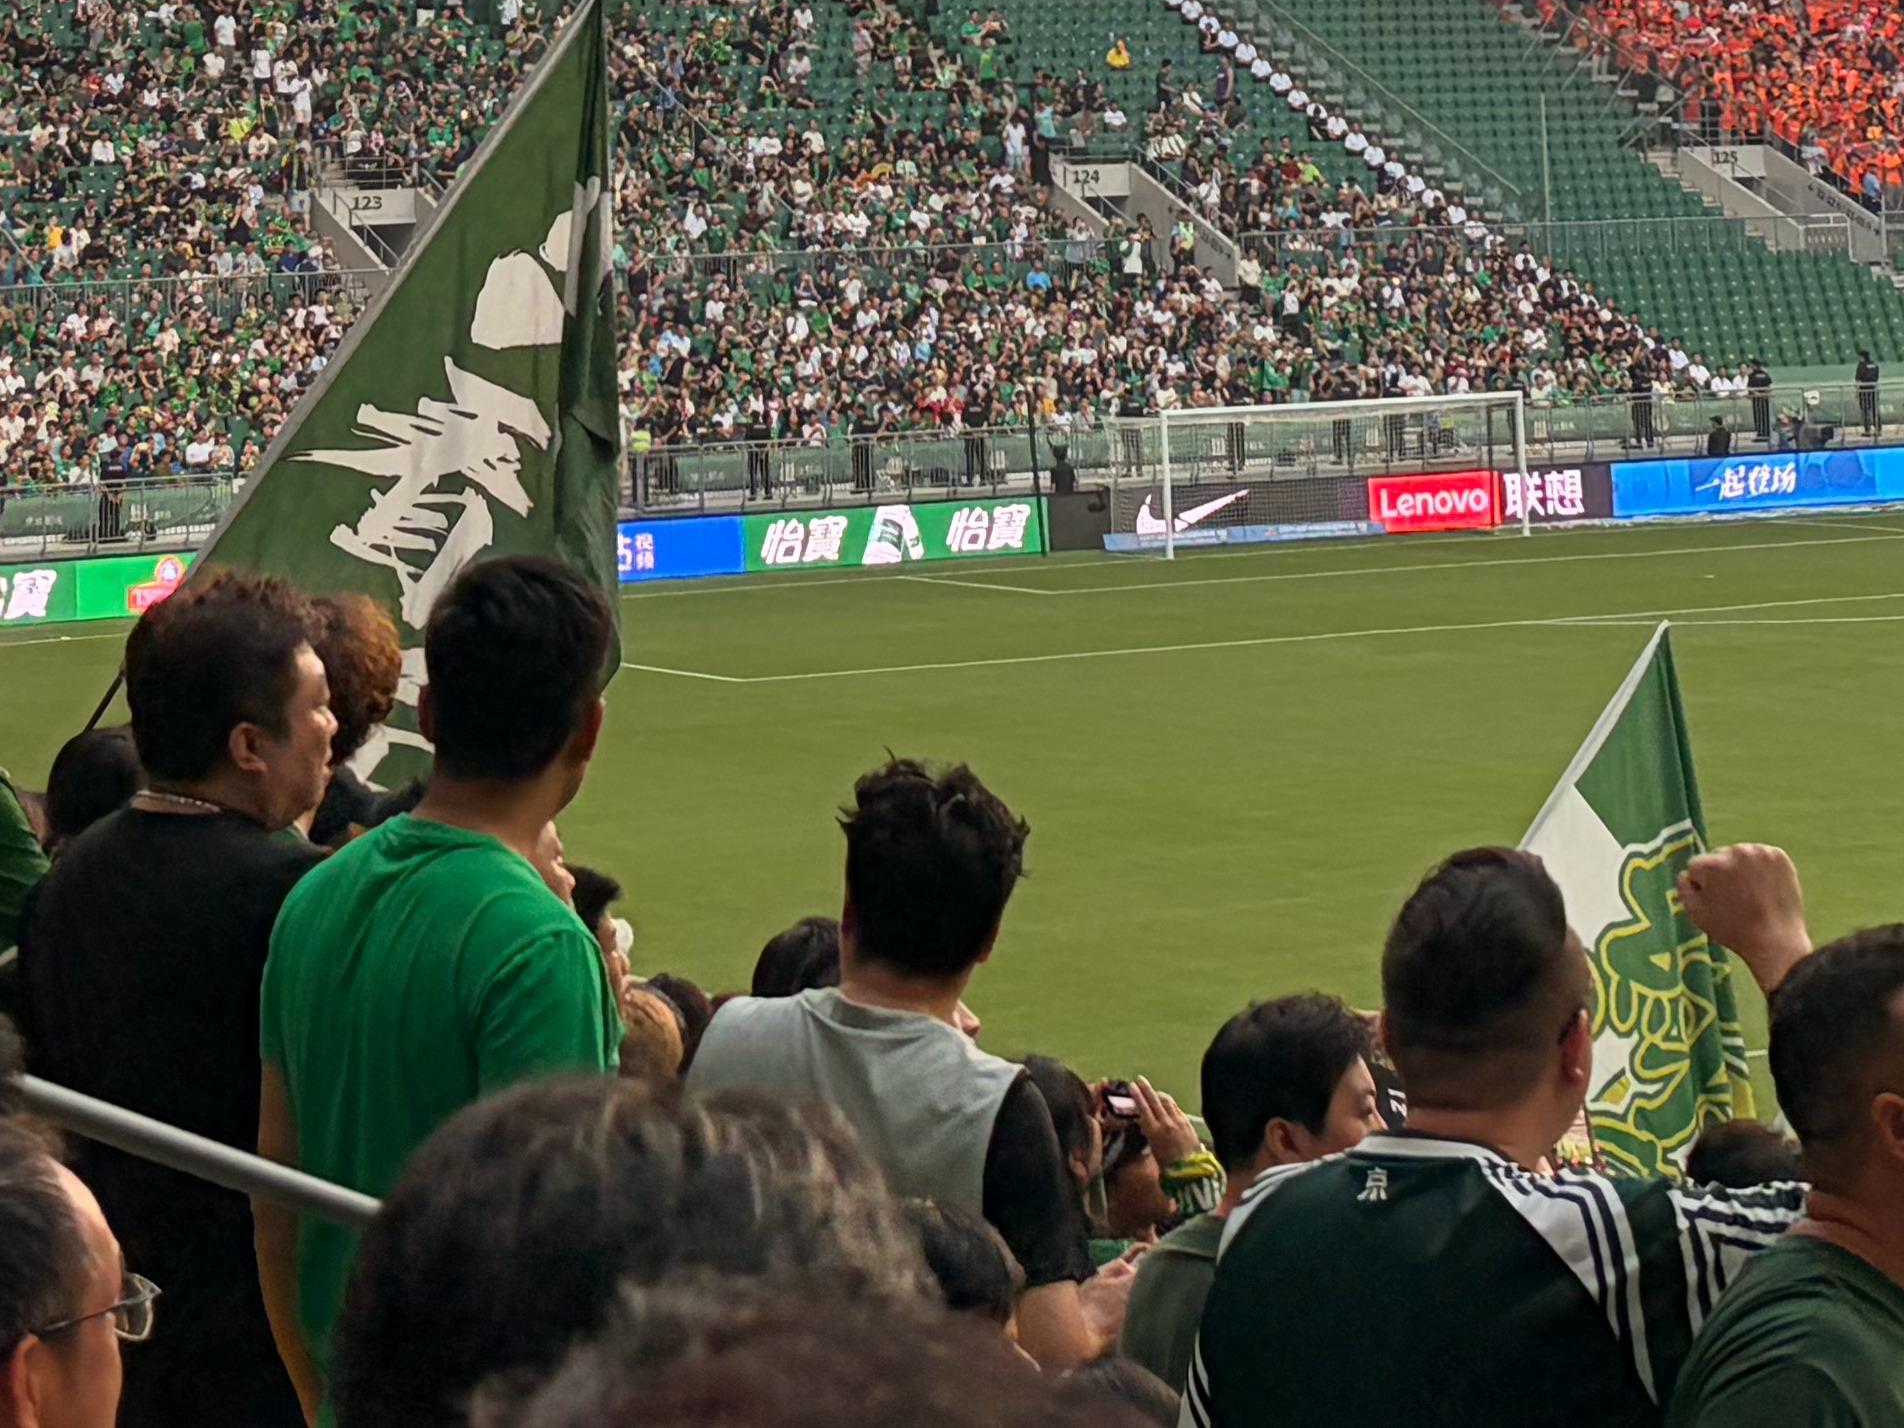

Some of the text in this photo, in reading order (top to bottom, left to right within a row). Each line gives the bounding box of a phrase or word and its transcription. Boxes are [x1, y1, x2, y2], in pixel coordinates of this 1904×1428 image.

[1712, 150, 1738, 165] 125
[1073, 170, 1100, 185] 124
[352, 195, 383, 211] 123
[1380, 488, 1489, 518] Lenovo
[1503, 469, 1585, 519] 联想
[1356, 1166, 1389, 1202] 京
